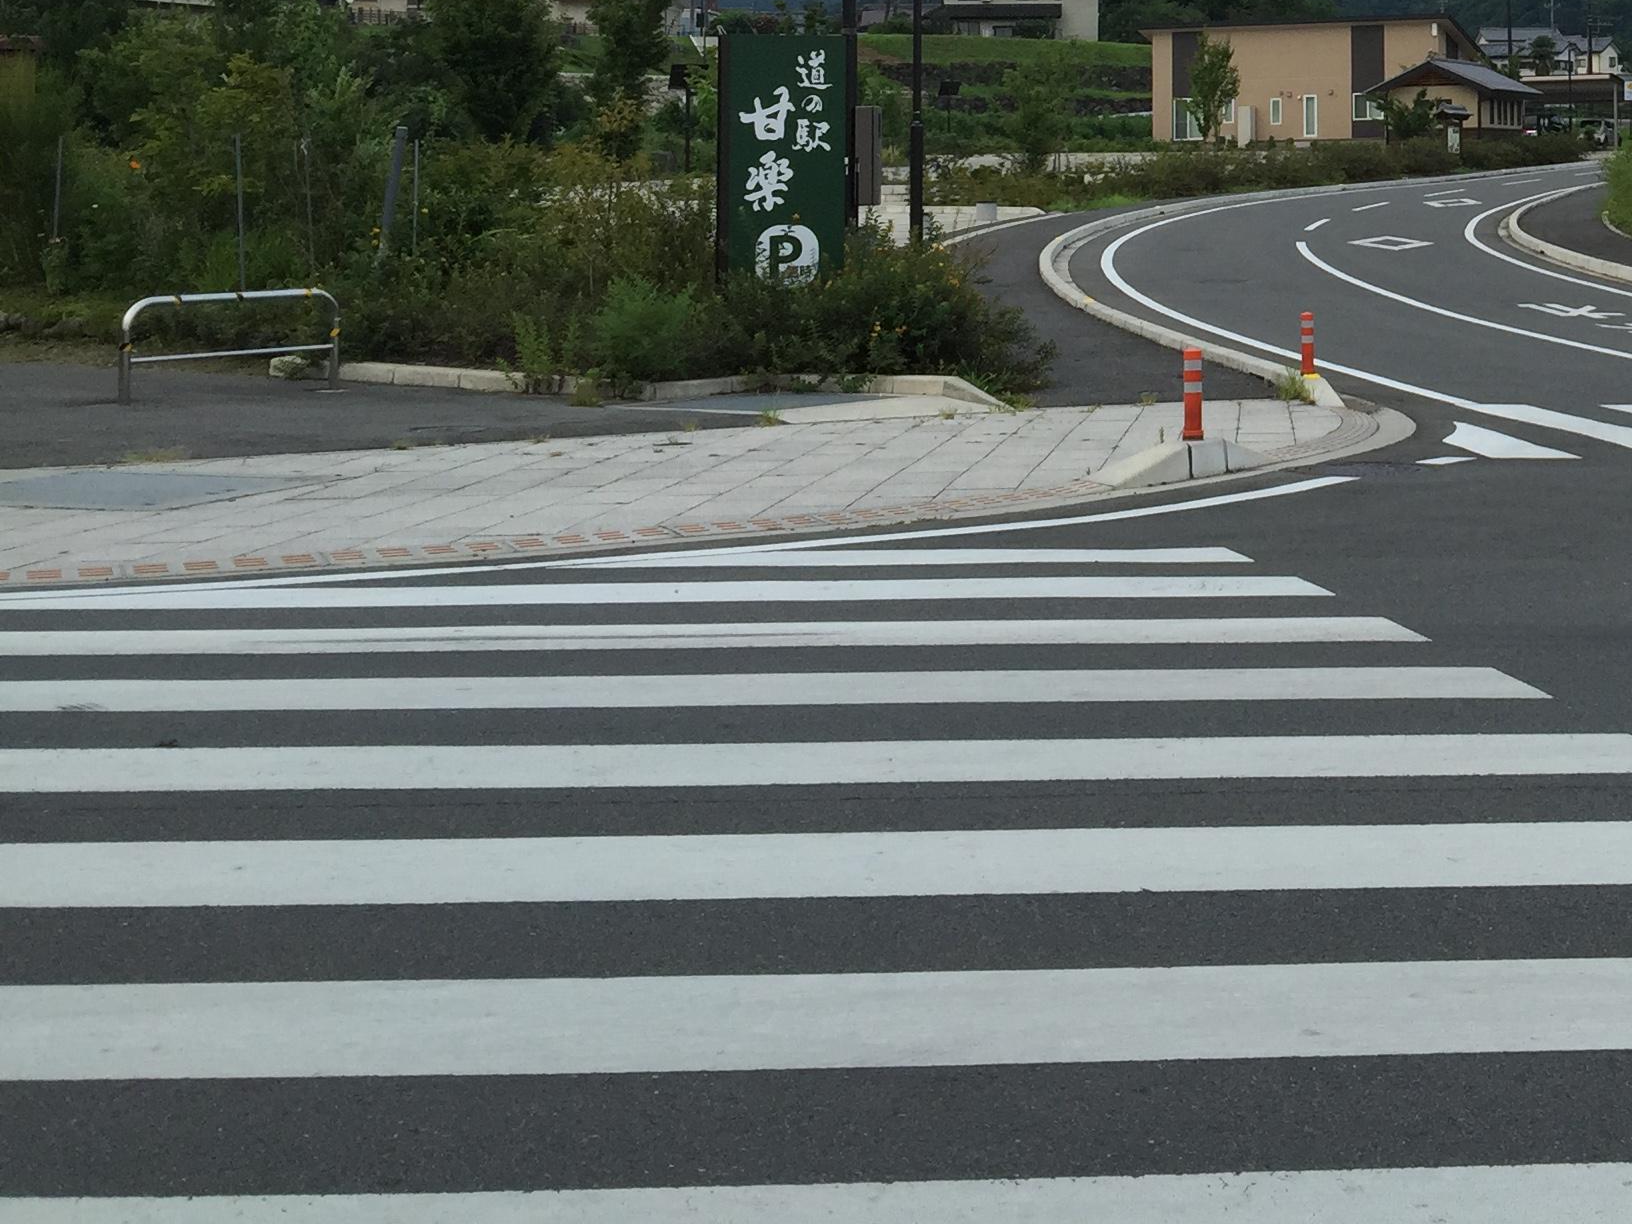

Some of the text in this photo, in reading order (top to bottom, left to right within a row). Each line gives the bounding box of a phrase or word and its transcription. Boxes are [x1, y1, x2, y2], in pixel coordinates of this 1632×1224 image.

[739, 86, 794, 211] 甘楽
[791, 49, 833, 152] 道の駅
